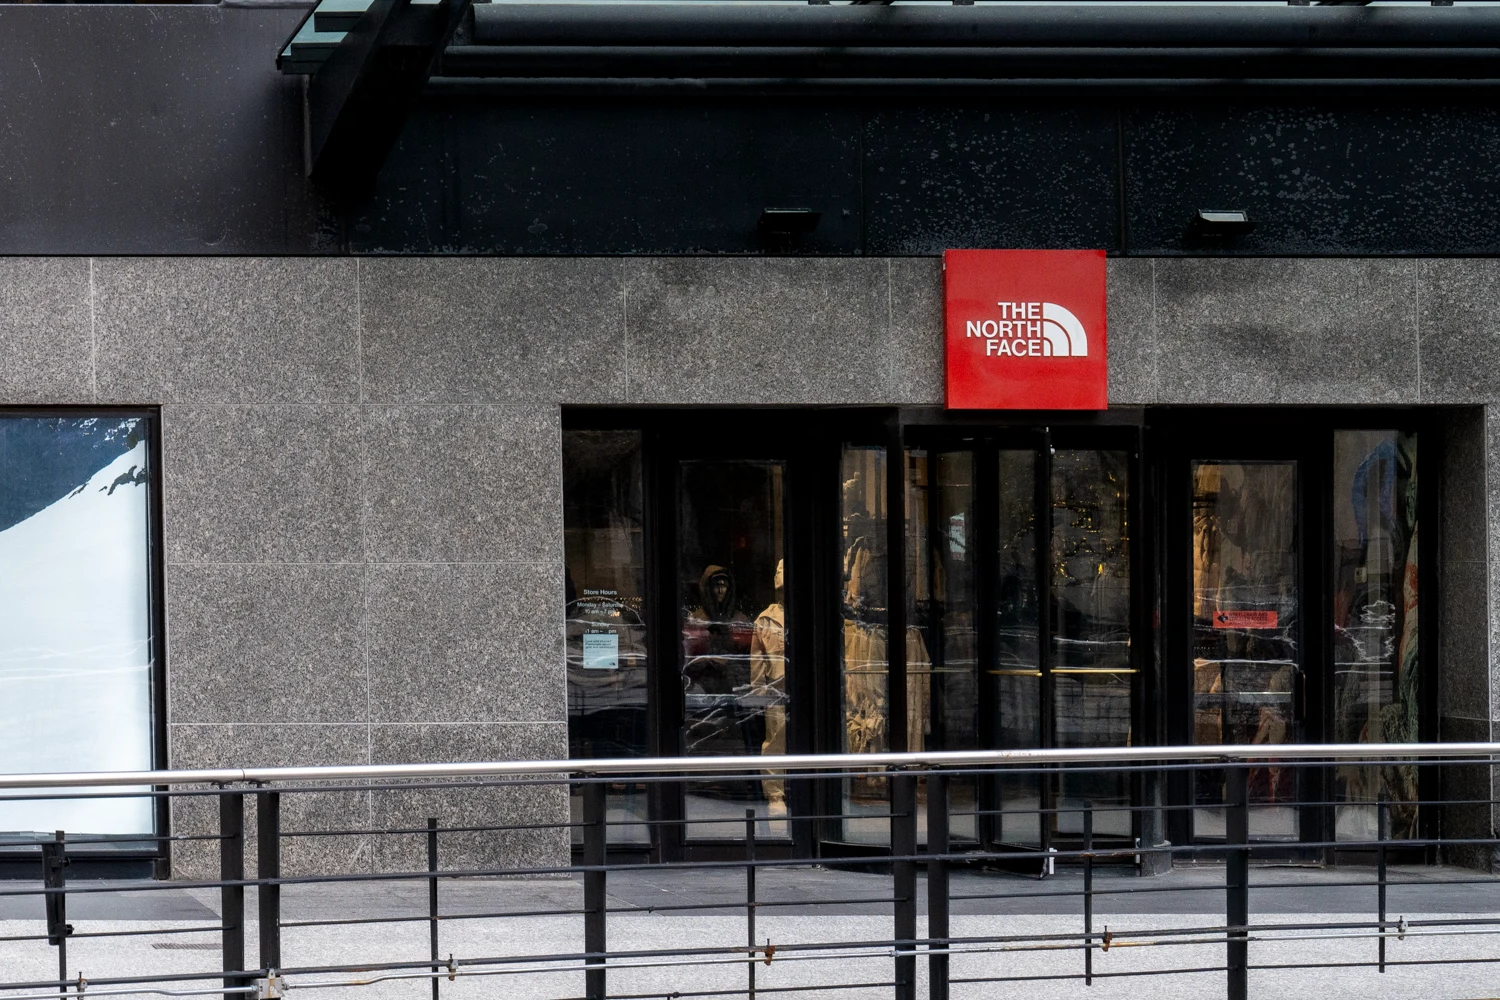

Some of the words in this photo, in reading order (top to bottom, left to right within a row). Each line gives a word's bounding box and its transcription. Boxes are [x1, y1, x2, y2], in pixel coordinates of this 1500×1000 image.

[998, 302, 1040, 319] THE
[967, 320, 1041, 338] NORTH
[987, 339, 1041, 356] FACE
